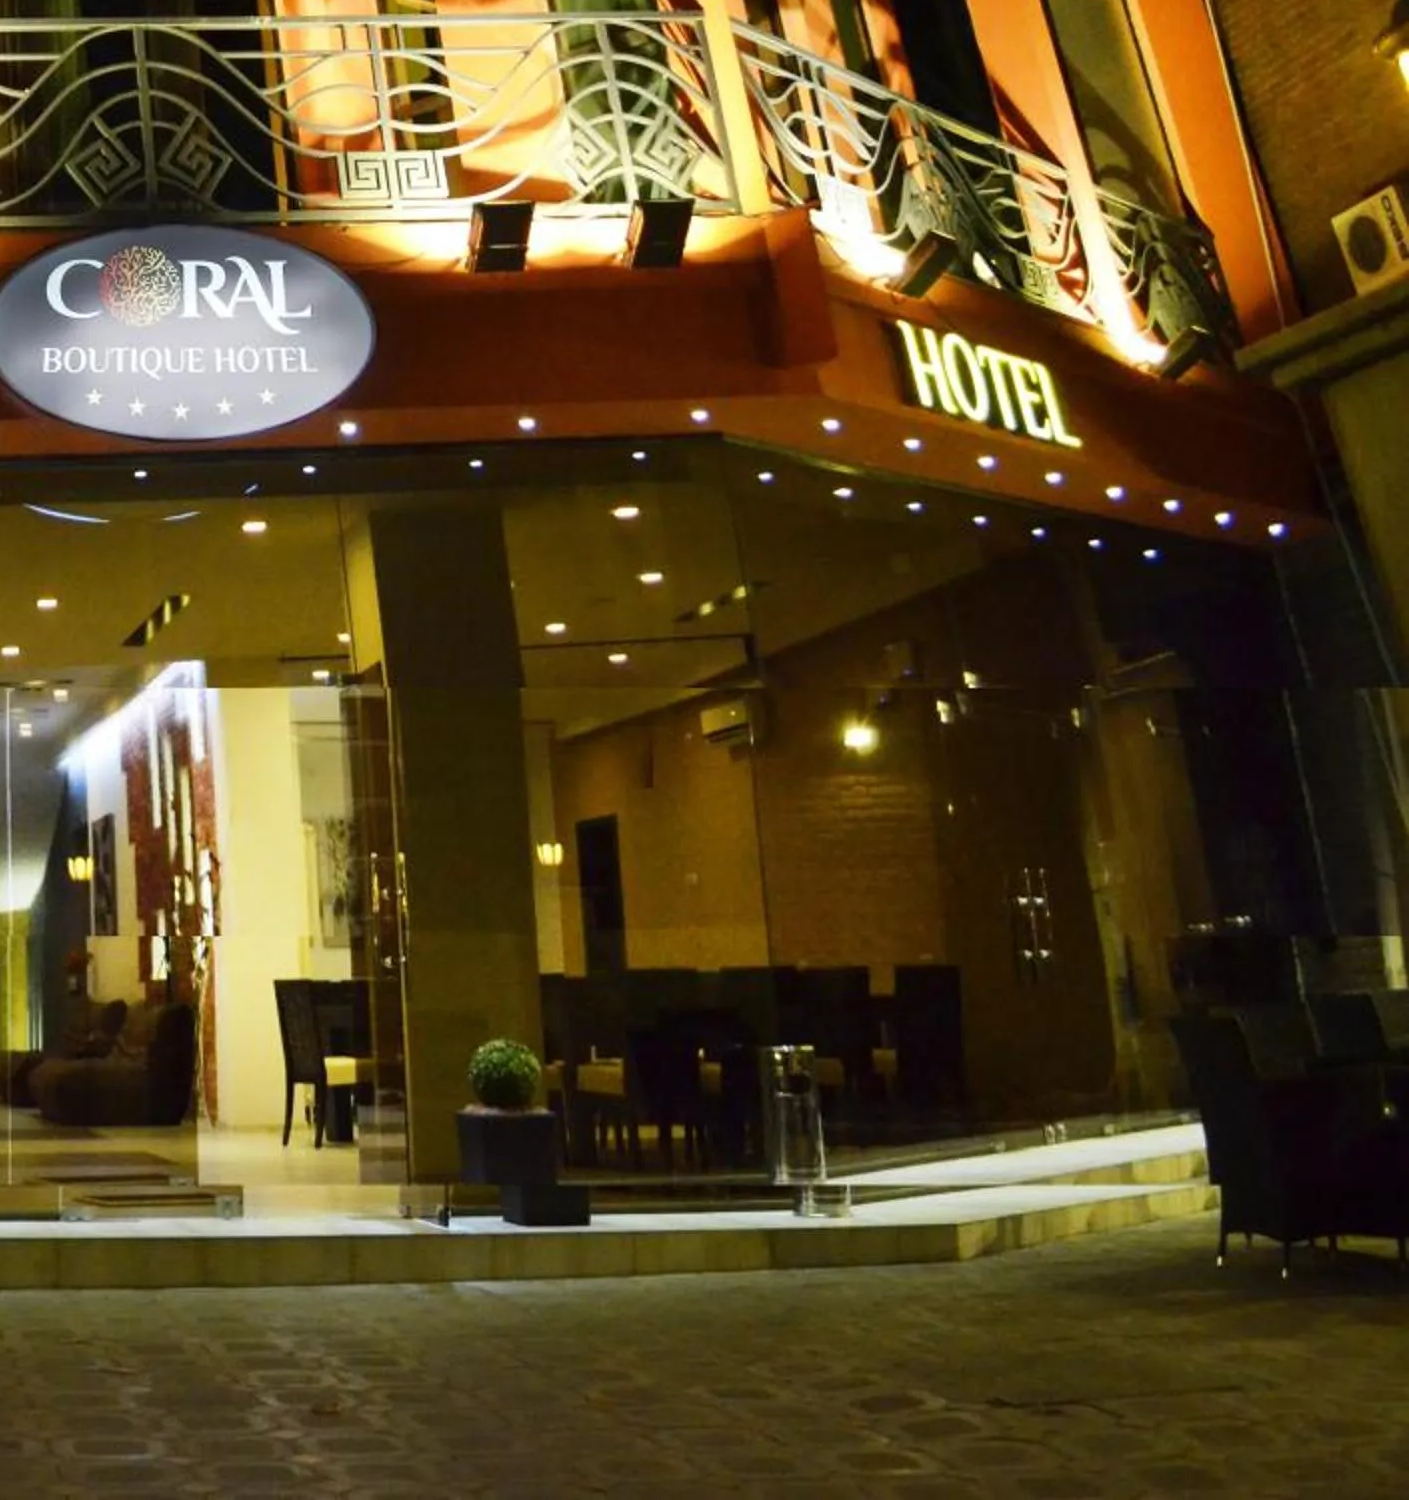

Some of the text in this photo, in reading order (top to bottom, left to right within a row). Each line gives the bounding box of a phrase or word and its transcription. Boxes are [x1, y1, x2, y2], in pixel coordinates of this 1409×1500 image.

[45, 245, 312, 335] CORAL
[41, 345, 319, 381] BOUTIQUE HOTEL
[895, 318, 1084, 448] HOTEL
